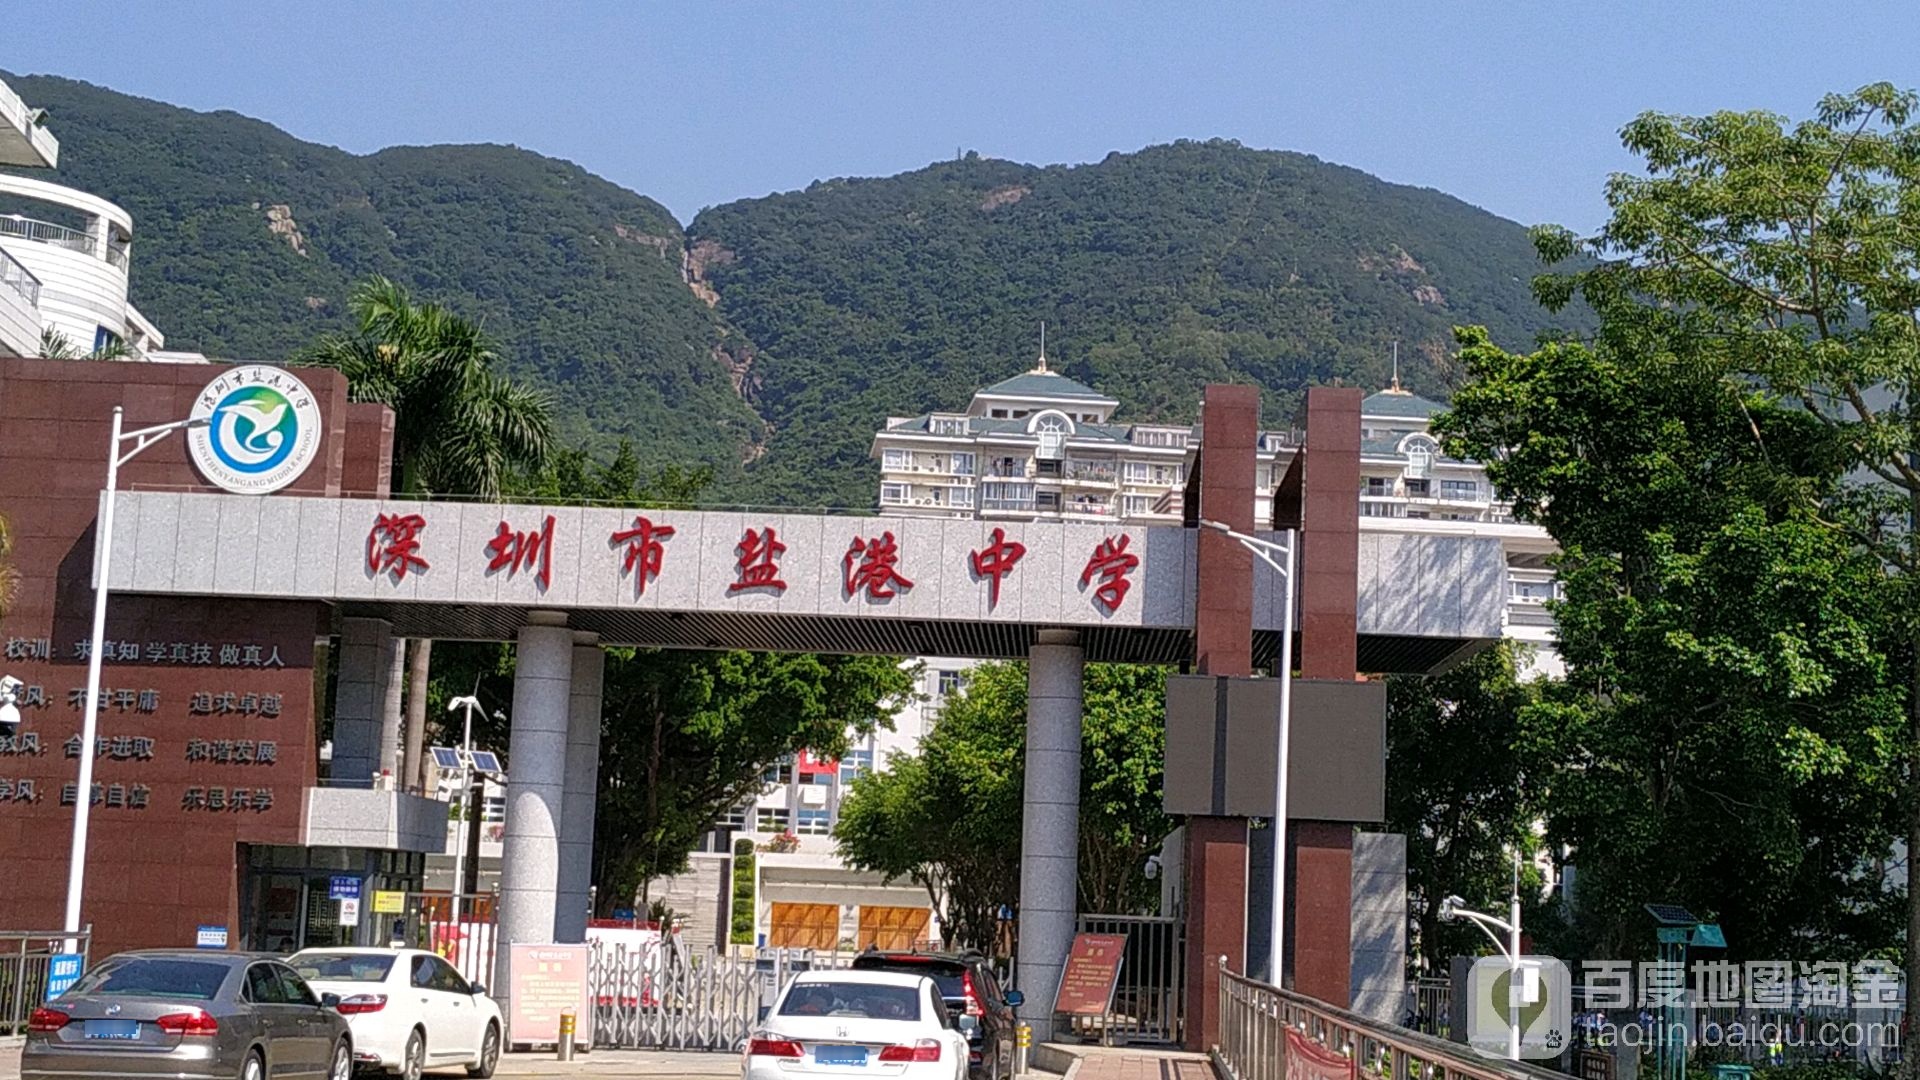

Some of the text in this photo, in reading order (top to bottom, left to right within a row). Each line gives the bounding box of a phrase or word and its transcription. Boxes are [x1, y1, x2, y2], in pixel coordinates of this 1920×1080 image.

[267, 460, 296, 485] MIDDLE
[296, 426, 313, 462] SCHOOL
[369, 513, 1140, 611] 深圳市盐港中学
[146, 642, 213, 664] 学真技
[219, 644, 285, 666] 做真人
[191, 691, 283, 715] 追求卓越
[188, 740, 277, 762] 和谐发展
[183, 786, 274, 809] 乐思乐学
